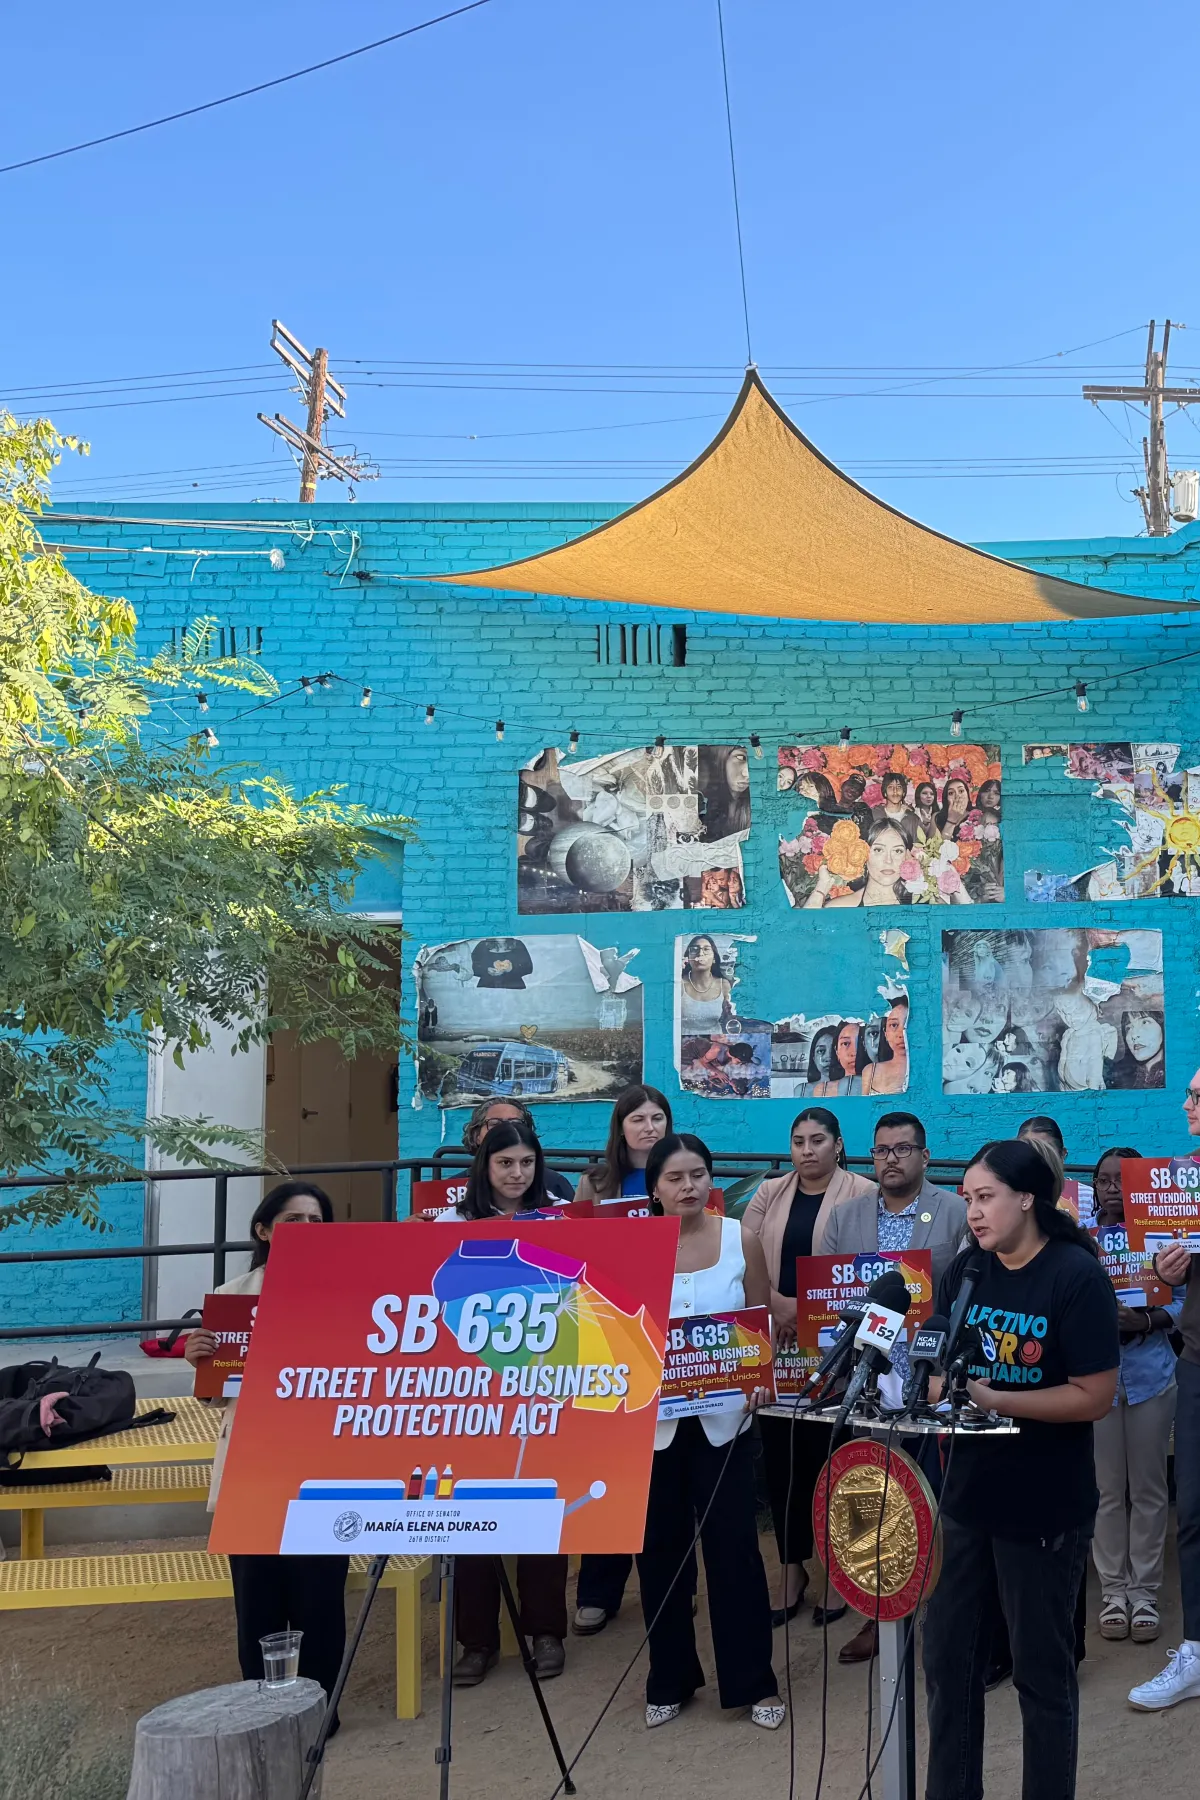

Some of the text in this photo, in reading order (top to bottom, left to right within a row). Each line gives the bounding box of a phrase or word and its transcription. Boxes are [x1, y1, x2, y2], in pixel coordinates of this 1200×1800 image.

[1151, 1168, 1172, 1189] SB
[446, 1187, 467, 1205] SB
[1131, 1193, 1156, 1204] STREET
[1158, 1192, 1192, 1204] VENDOR
[1148, 1205, 1199, 1217] PROTECTION
[1134, 1219, 1167, 1227] Resilientes,
[1120, 1252, 1154, 1265] BUSINE
[832, 1263, 856, 1285] SB
[1125, 1263, 1141, 1274] ACT
[807, 1287, 869, 1300] STREET VENDO
[367, 1292, 560, 1355] SB 635
[951, 1304, 1048, 1339] LECTIVO
[215, 1332, 253, 1344] STREE
[692, 1323, 730, 1348] 635
[877, 1327, 895, 1341] 52
[669, 1350, 712, 1366] VENDOR
[713, 1345, 760, 1361] BUSINESS
[213, 1360, 247, 1368] Resilie
[662, 1361, 738, 1381] ROTECTION ACT
[681, 1376, 731, 1388] Desafiantes,
[732, 1372, 761, 1383] Unidos
[790, 1369, 805, 1379] ACT
[968, 1362, 1043, 1384] UNITARIO
[276, 1364, 630, 1399] STREET VENDOR BUSINESS
[333, 1403, 564, 1437] PROTECTION ACT
[436, 1510, 461, 1518] SENATOR
[364, 1519, 498, 1532] MARÍA ELENA DURAZO
